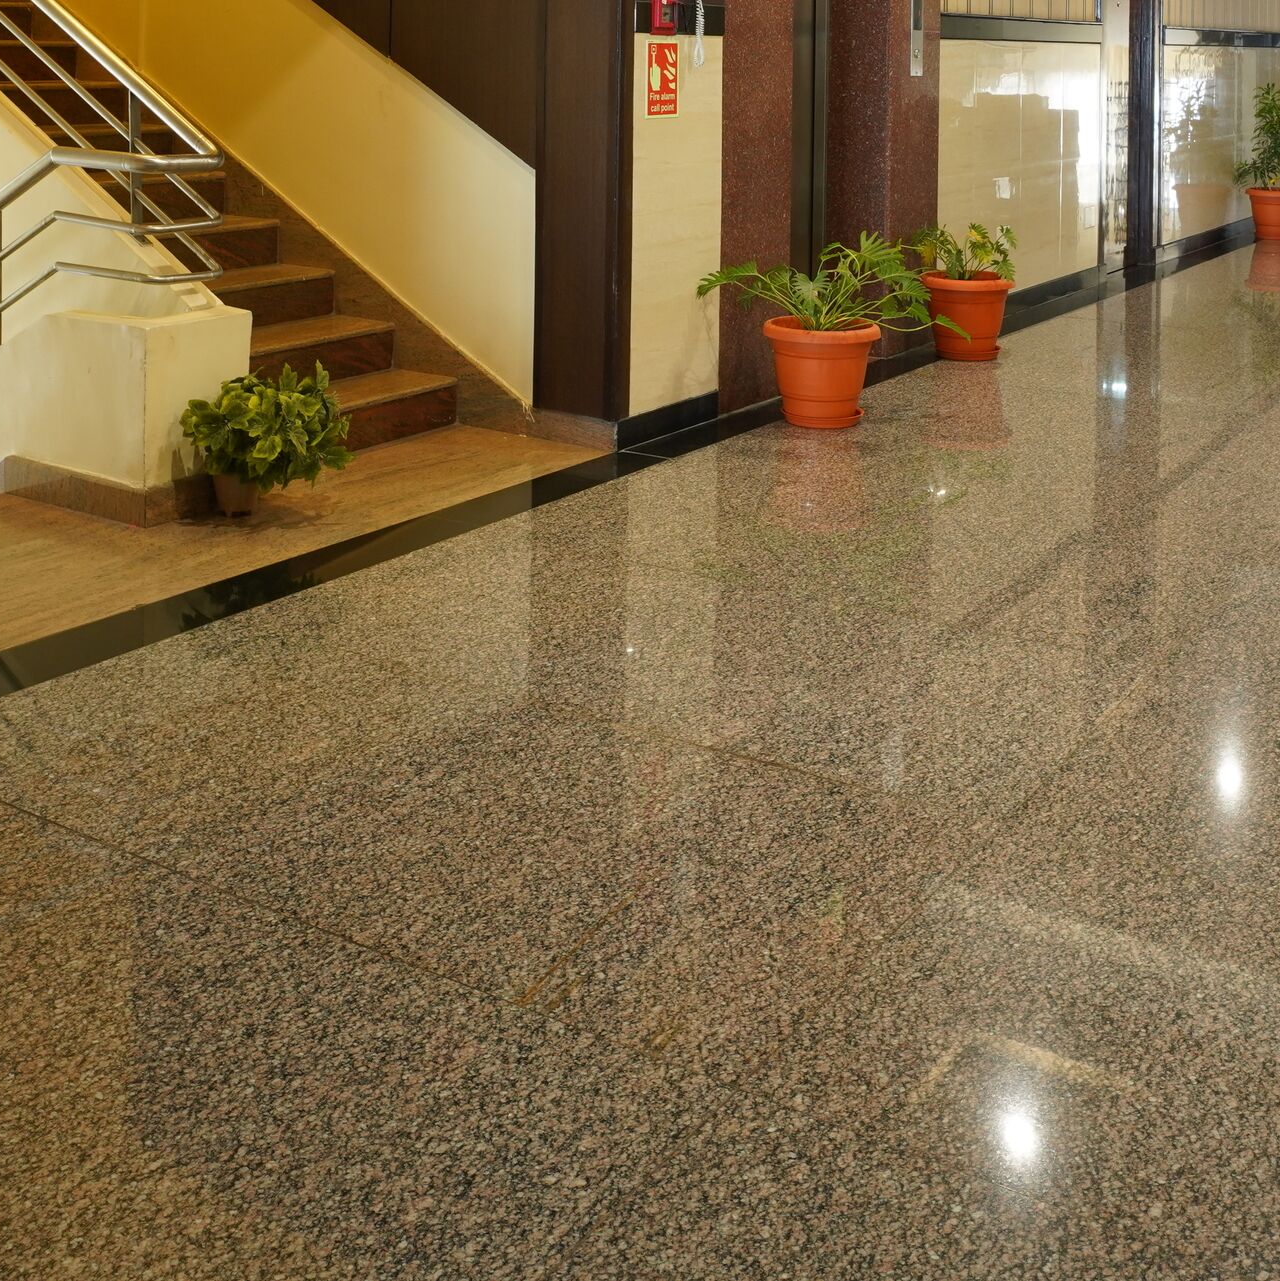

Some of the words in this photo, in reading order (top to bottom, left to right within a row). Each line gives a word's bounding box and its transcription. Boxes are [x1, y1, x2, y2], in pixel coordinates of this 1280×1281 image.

[649, 92, 660, 101] Fire
[660, 92, 676, 101] alarm
[650, 104, 661, 113] call
[660, 103, 675, 114] point
